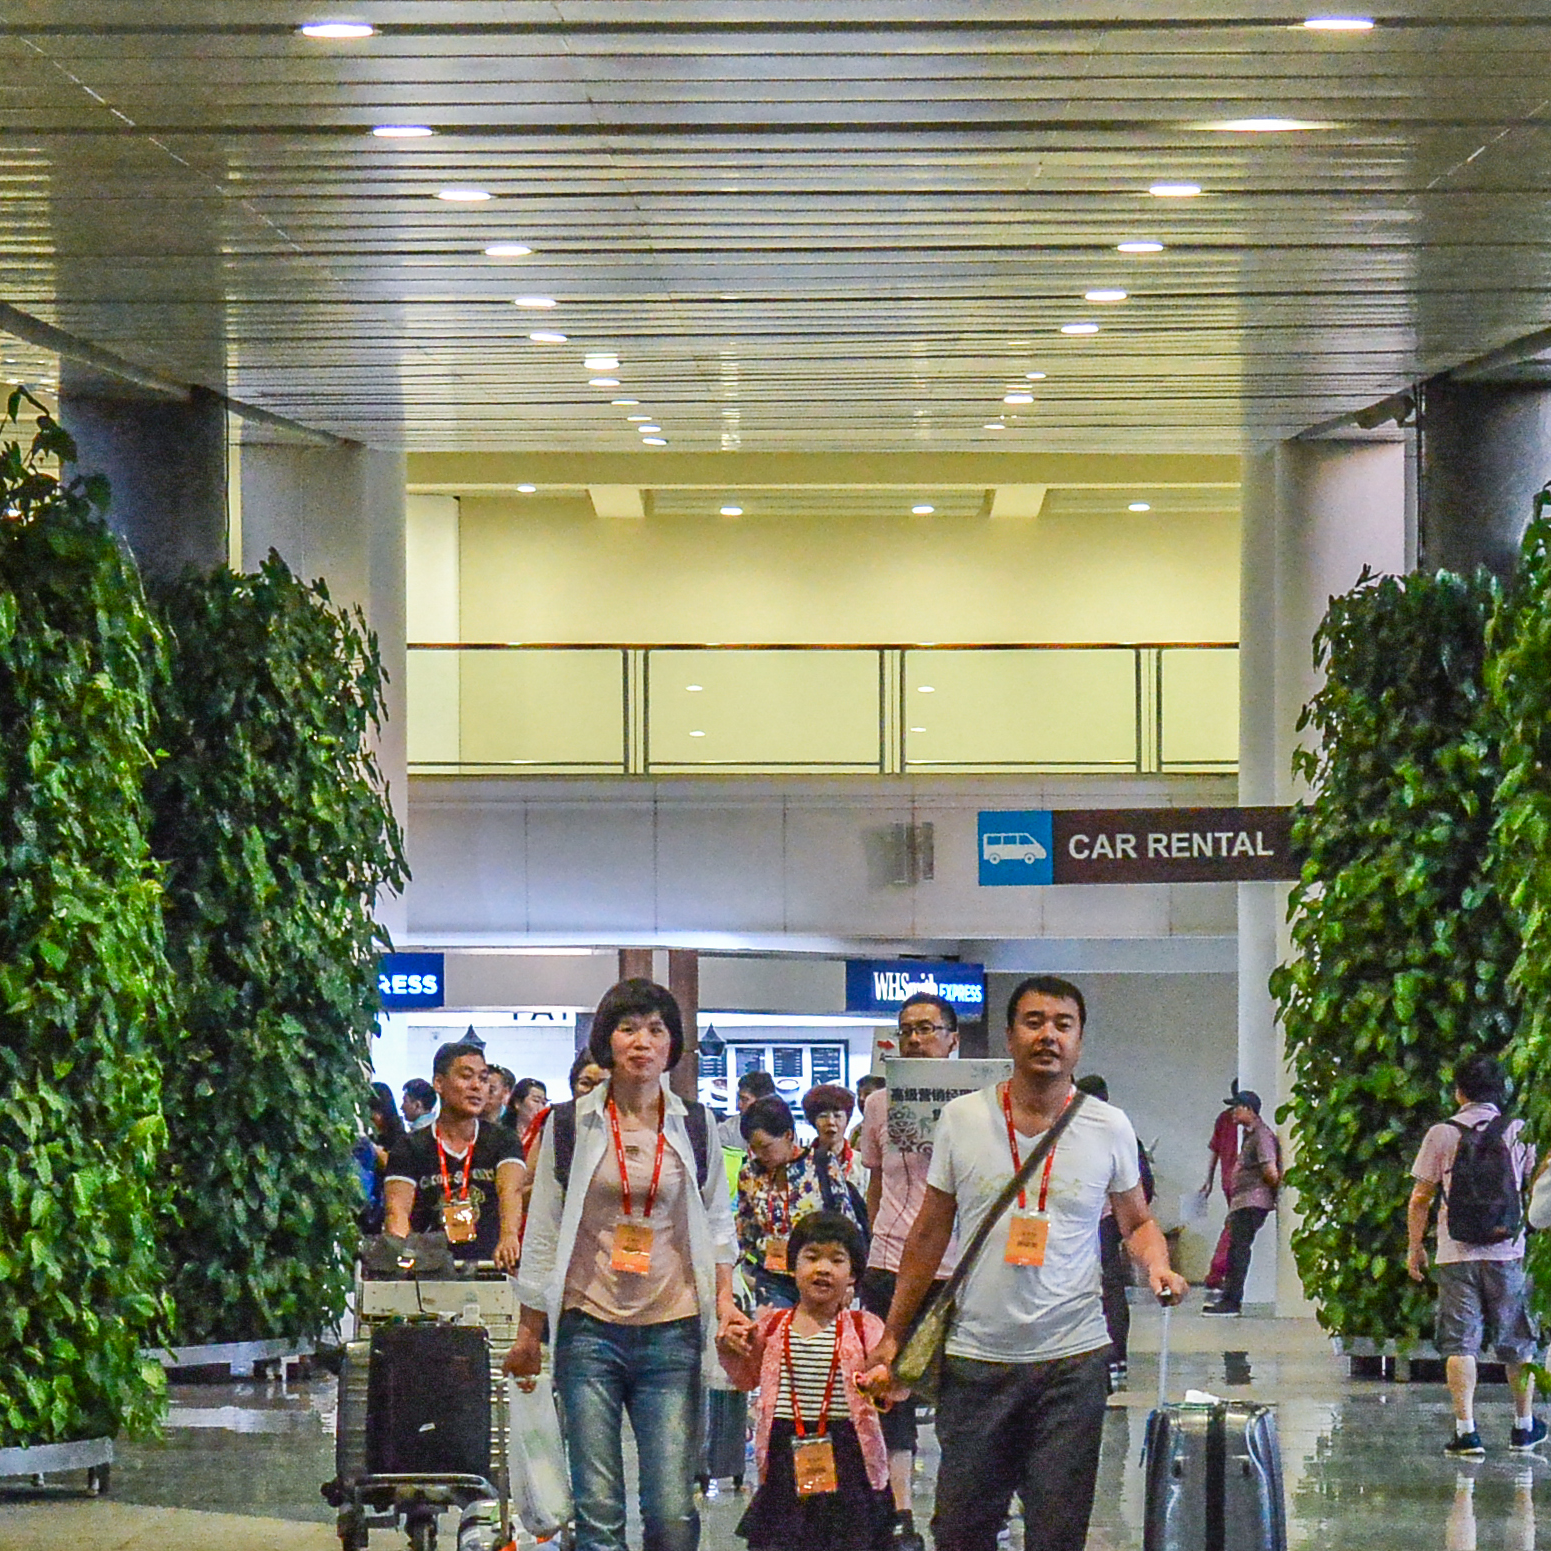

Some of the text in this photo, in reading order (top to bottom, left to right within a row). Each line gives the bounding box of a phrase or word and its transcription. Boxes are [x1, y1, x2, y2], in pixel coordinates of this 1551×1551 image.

[1068, 831, 1274, 860] CAR RENTAL
[938, 983, 983, 1003] EXPRESS
[891, 1088, 980, 1102] 高级营销经
